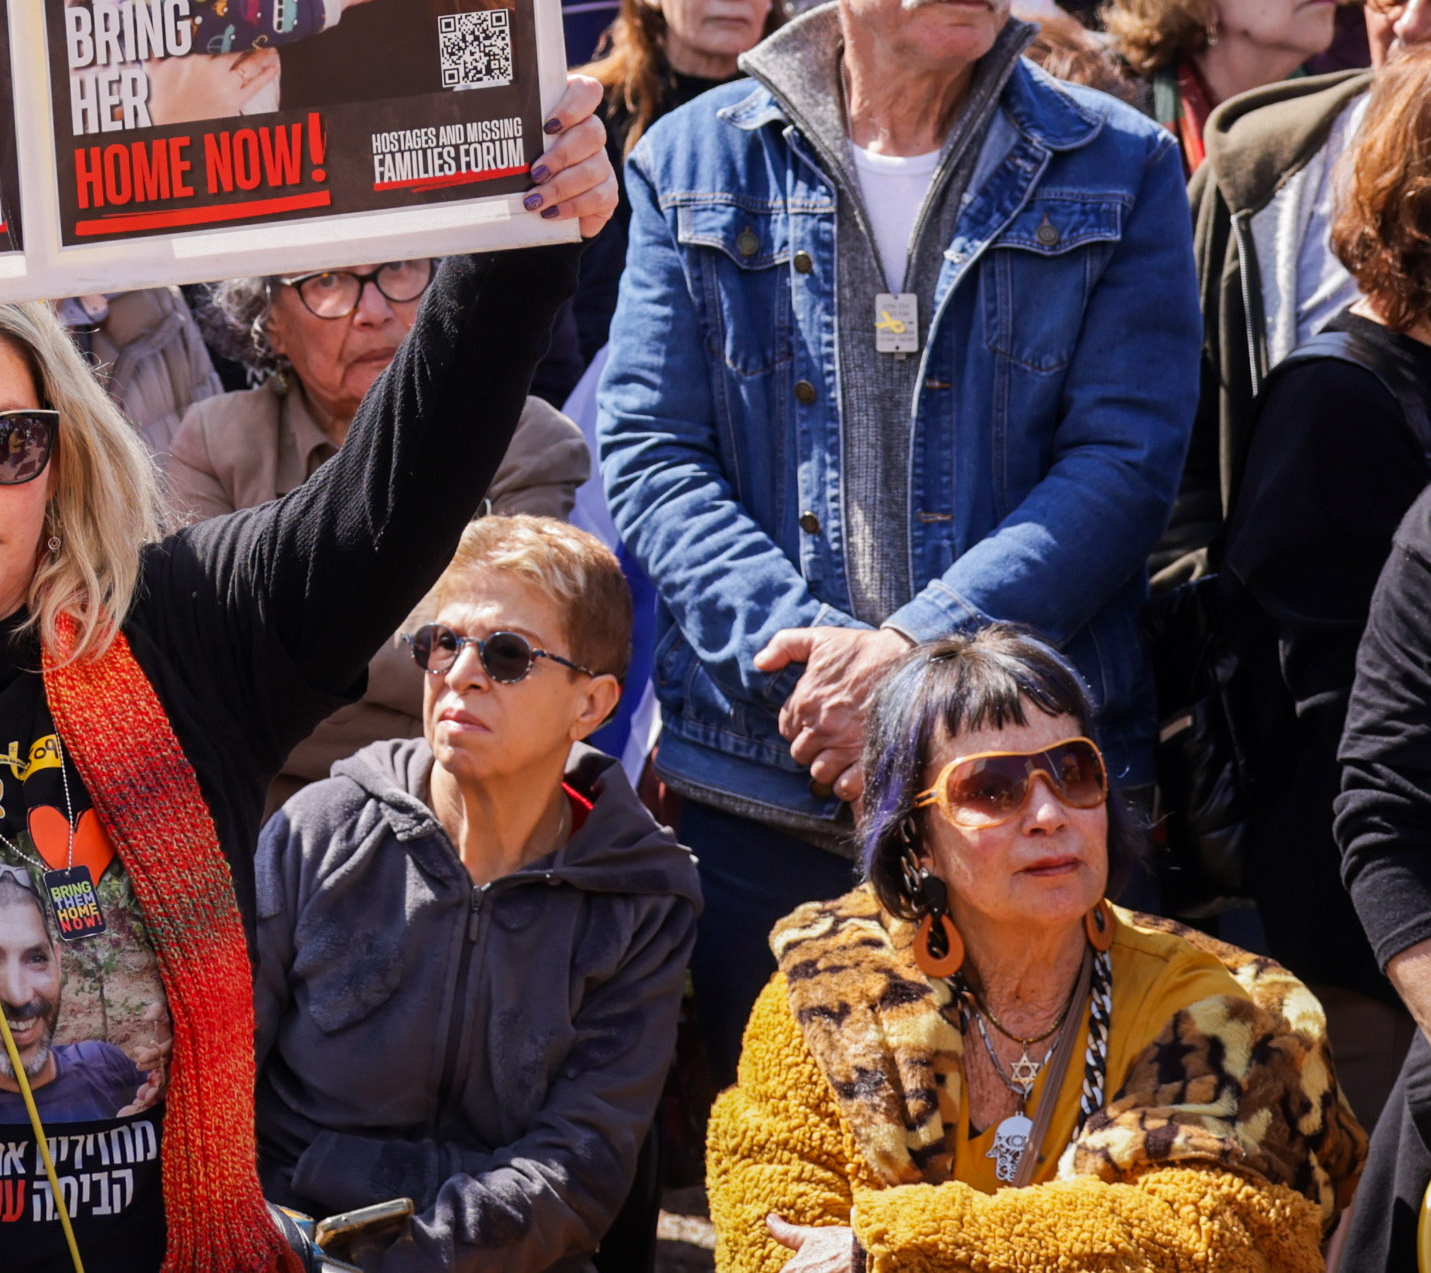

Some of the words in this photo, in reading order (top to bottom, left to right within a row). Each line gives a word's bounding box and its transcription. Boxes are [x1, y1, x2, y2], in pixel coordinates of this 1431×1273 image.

[71, 69, 152, 136] HER
[372, 126, 437, 154] HOSTAGES
[439, 124, 464, 146] AND
[466, 117, 522, 142] MISSING
[75, 136, 193, 209] HOME
[205, 112, 327, 194] NOW!
[373, 145, 456, 183] FAMILIES
[459, 138, 525, 174] FORUM
[50, 881, 92, 900] BRING
[54, 893, 96, 911] THEM
[57, 903, 99, 921] HOME
[61, 914, 103, 933] NOW!
[36, 1120, 157, 1175] מחזירים
